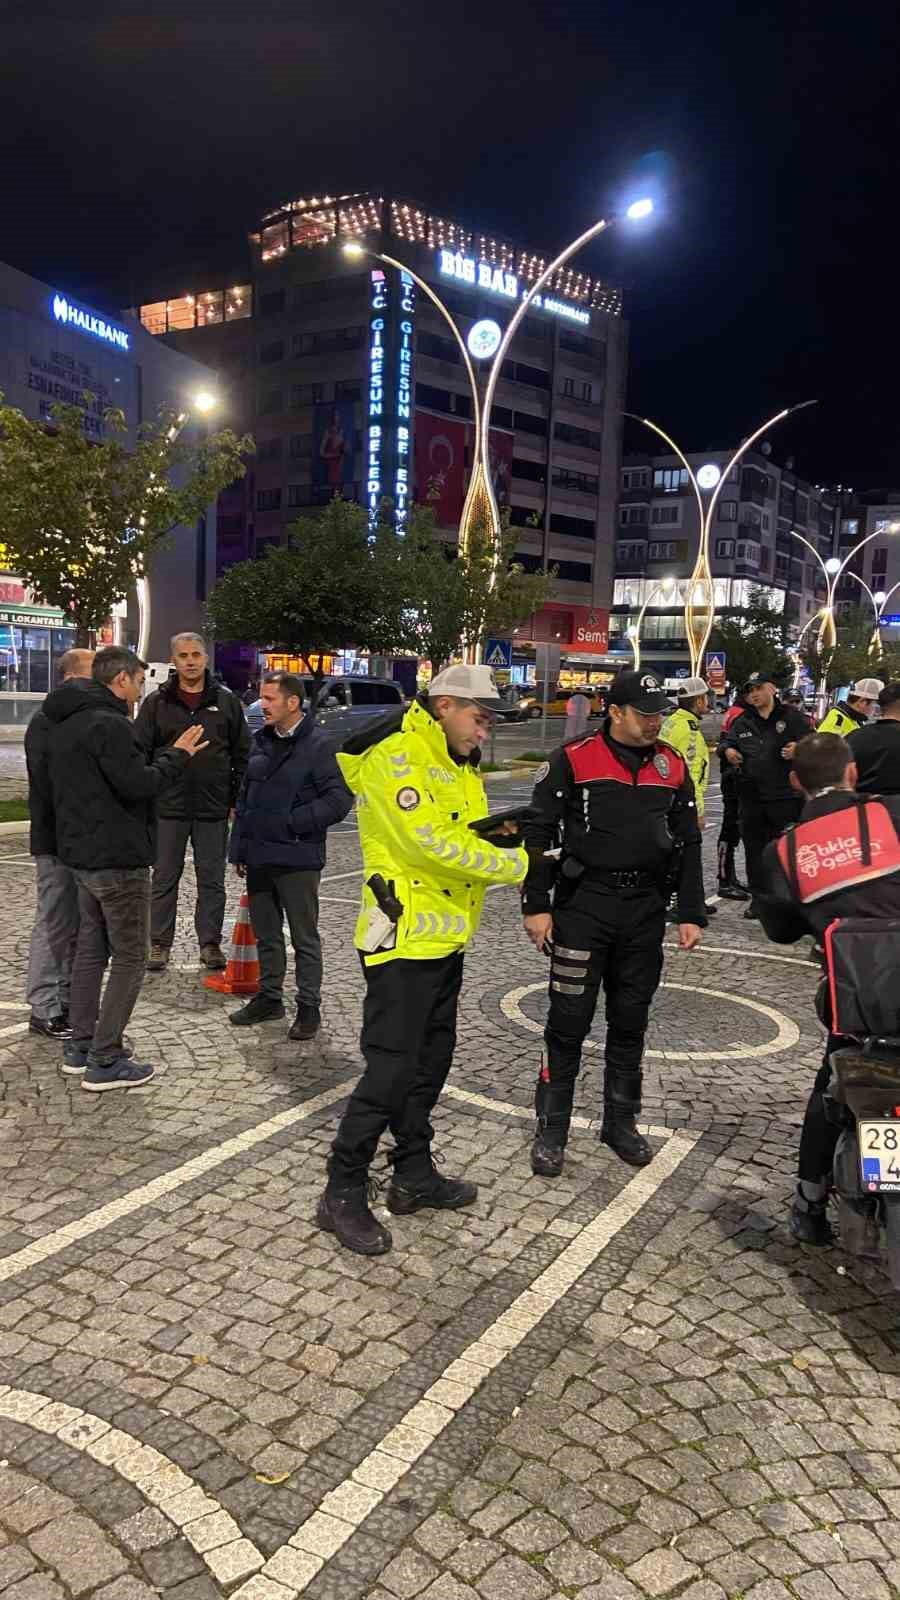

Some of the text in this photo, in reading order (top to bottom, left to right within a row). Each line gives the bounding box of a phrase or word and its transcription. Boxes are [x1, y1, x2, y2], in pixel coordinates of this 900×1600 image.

[68, 305, 129, 350] HALKBANK
[12, 614, 64, 627] LOKANTASI
[577, 627, 607, 645] Semt
[867, 1128, 898, 1151] 28
[887, 1156, 900, 1180] 4
